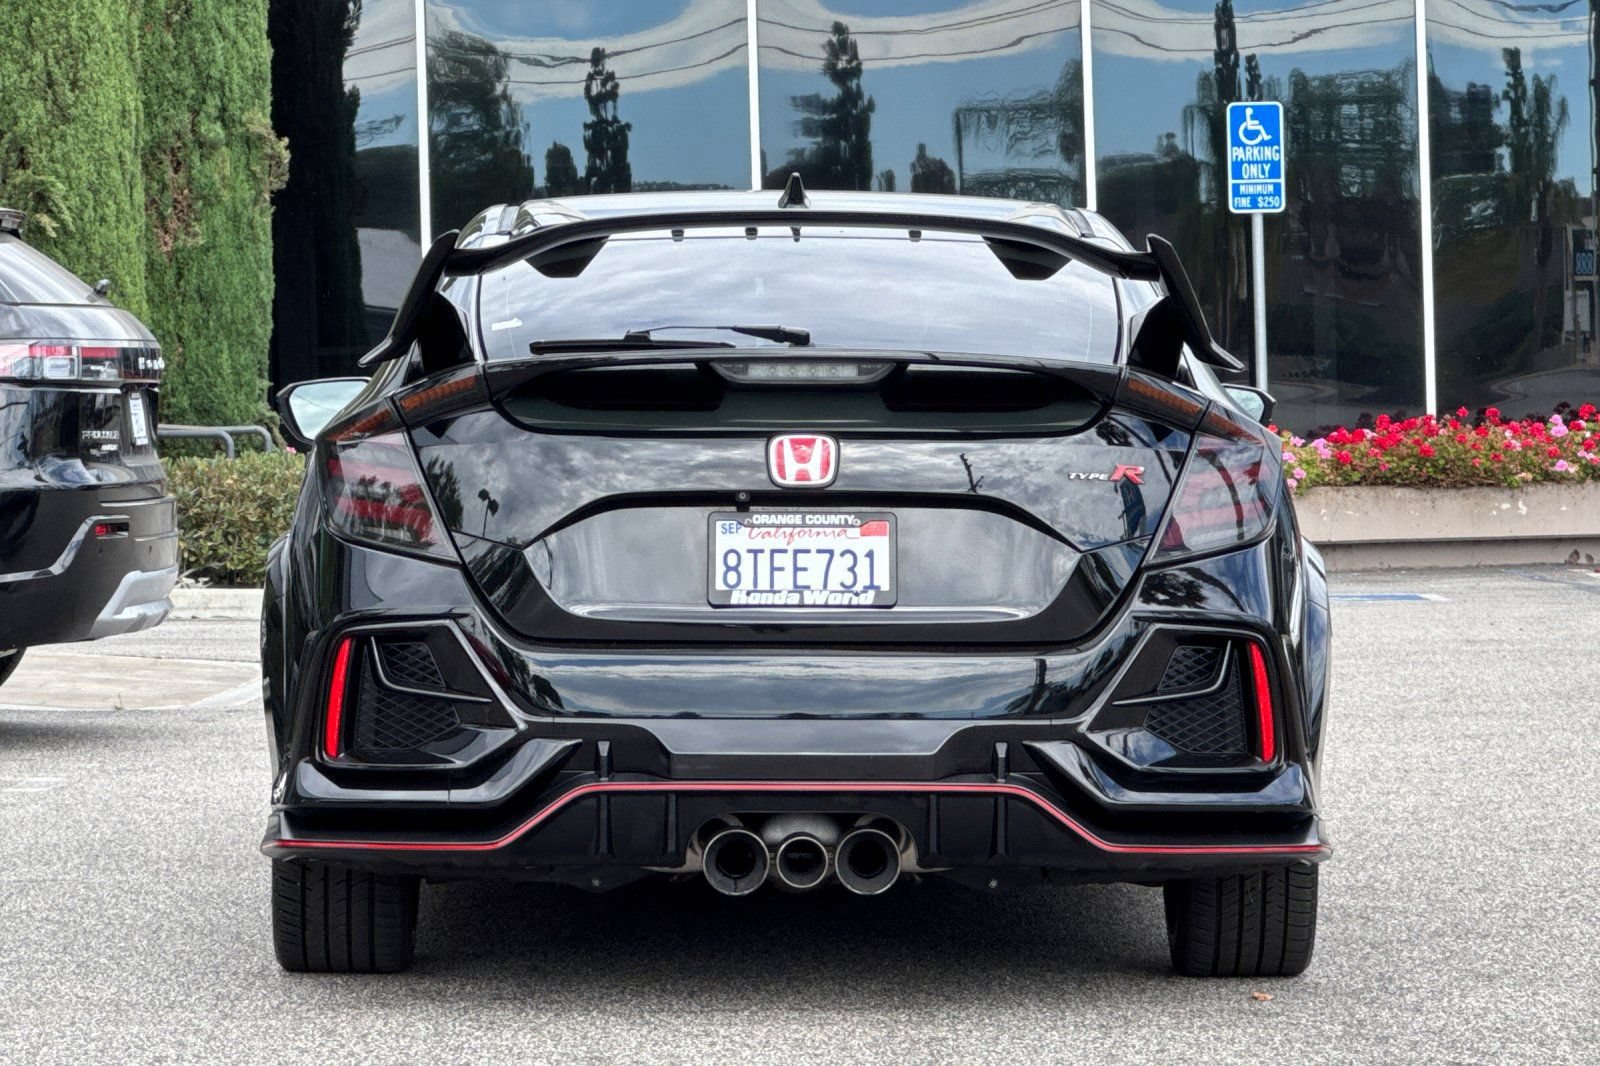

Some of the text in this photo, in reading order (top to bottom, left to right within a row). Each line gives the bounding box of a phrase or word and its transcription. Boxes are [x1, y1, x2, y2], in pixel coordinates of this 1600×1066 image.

[1232, 146, 1280, 161] PARKING
[1242, 163, 1271, 178] ONLY
[1240, 184, 1274, 194] MINIMUM
[1234, 196, 1280, 207] FINE $250
[1068, 463, 1145, 485] TYPE R
[752, 514, 853, 525] ORANGE COUNTY
[721, 523, 742, 535] SEP
[748, 527, 855, 545] California
[722, 548, 881, 590] 8TFE731
[730, 590, 800, 605] Honda
